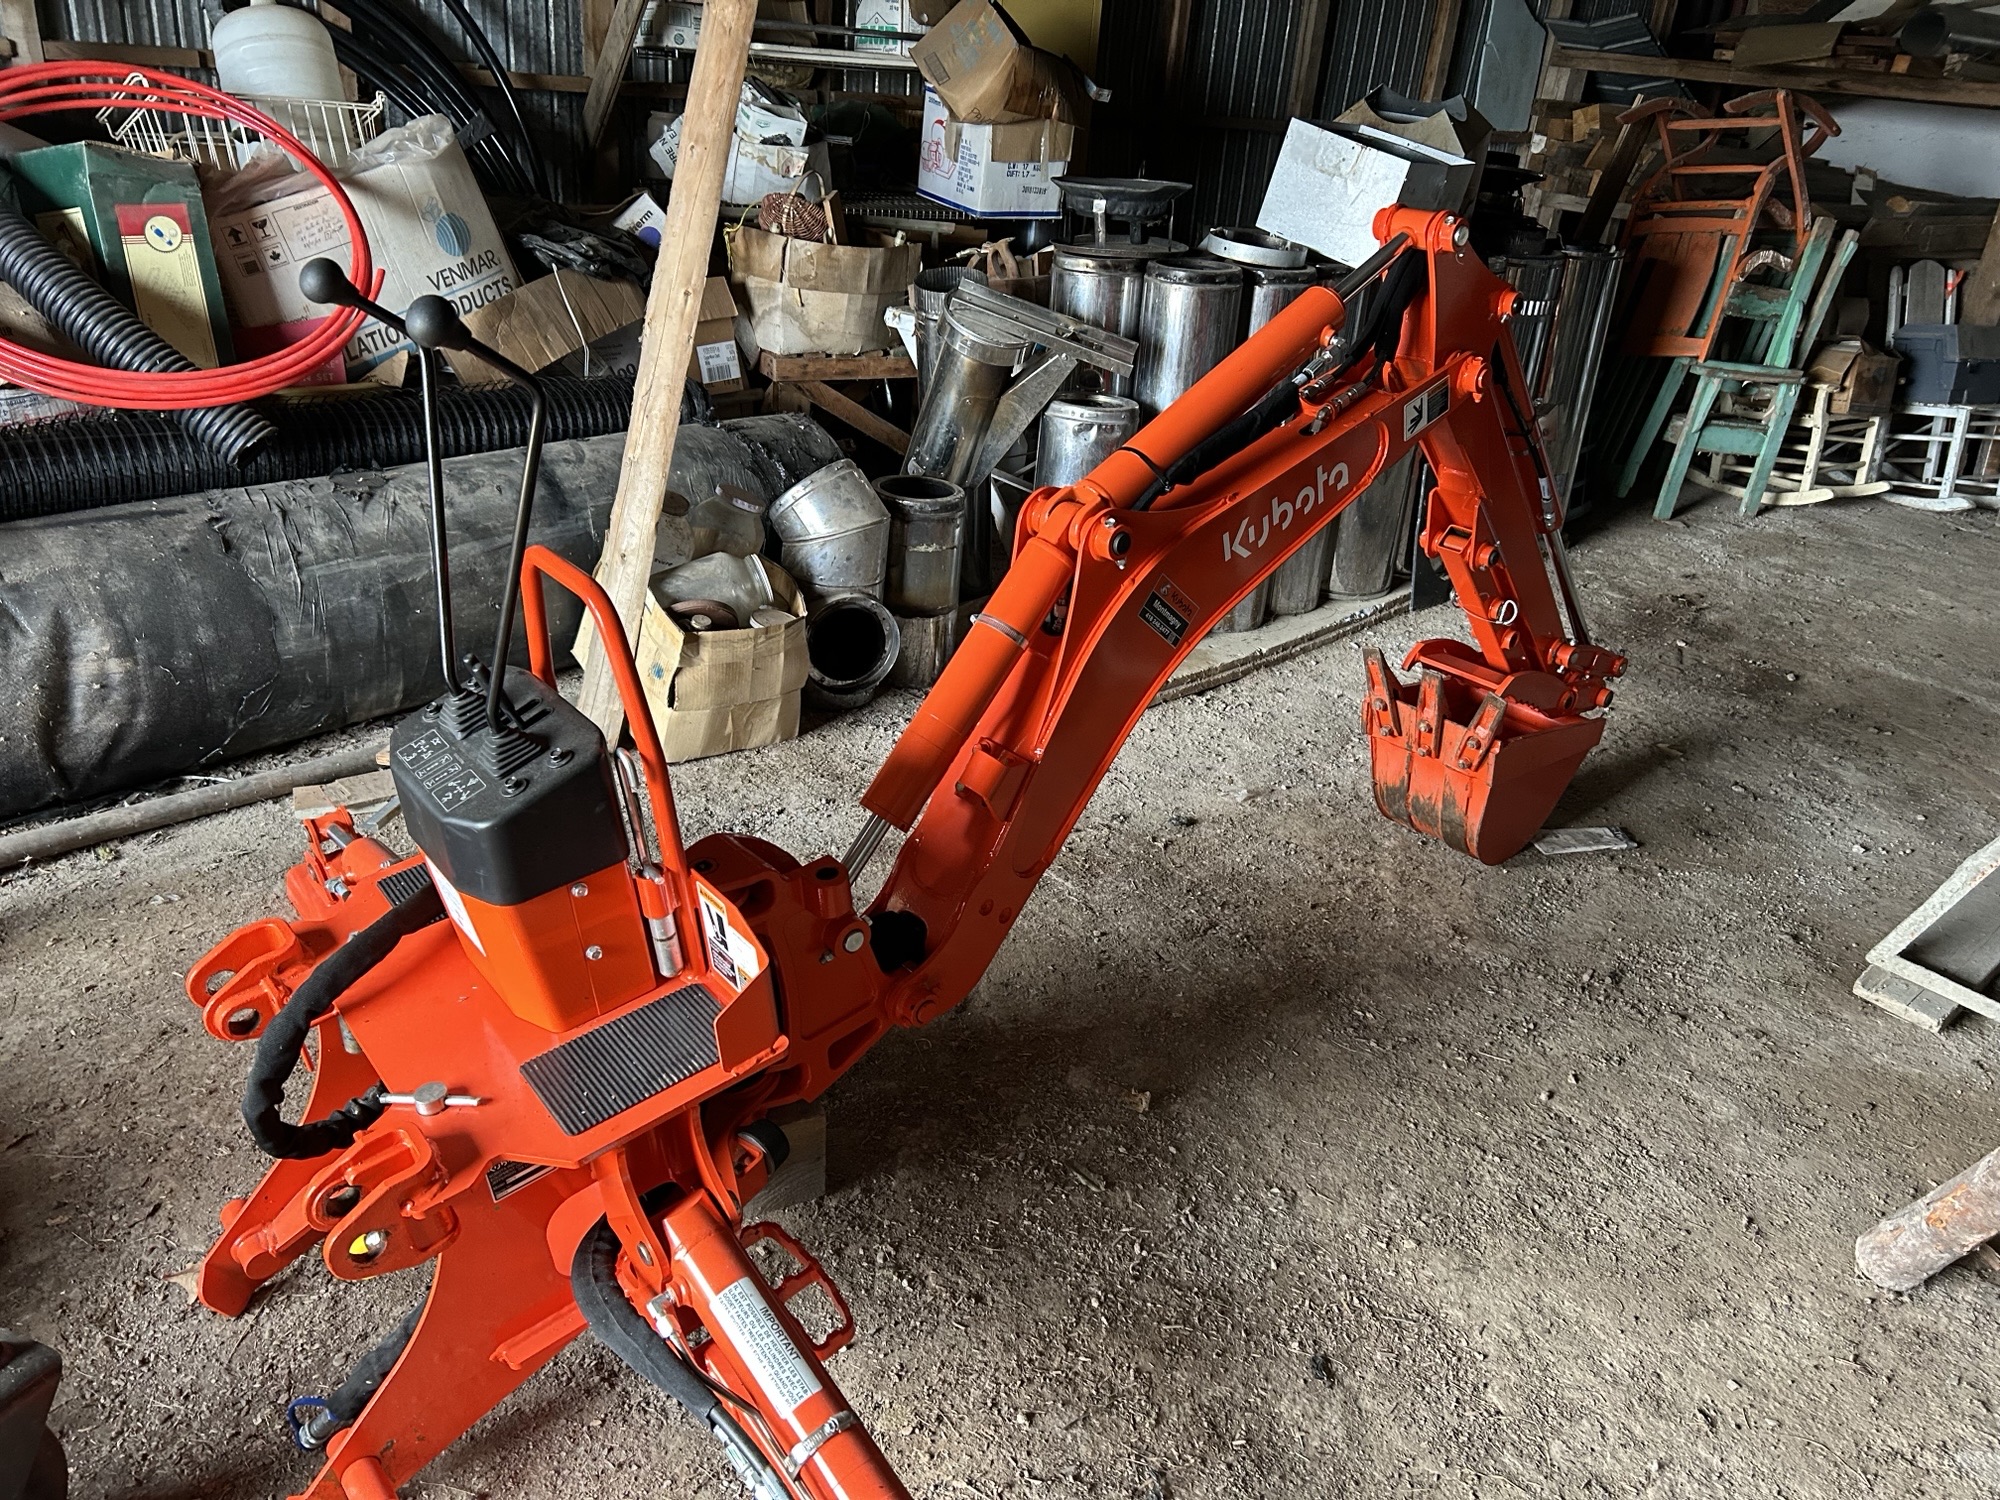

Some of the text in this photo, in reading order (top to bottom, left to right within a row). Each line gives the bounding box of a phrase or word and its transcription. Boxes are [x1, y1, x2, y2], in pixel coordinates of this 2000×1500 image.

[426, 250, 498, 291] VENMAR
[1222, 462, 1349, 562] Kubota
[1152, 599, 1182, 630] Montmagny
[722, 1292, 736, 1310] GODET
[734, 1310, 748, 1329] FAITES
[754, 1341, 776, 1370] ATTENTION
[772, 1369, 788, 1389] QUAND
[785, 1388, 798, 1404] VOUS
[737, 1290, 747, 1302] EST
[745, 1302, 765, 1330] POSSIBLE
[769, 1339, 789, 1366] HEURTER
[786, 1366, 797, 1378] LES
[748, 1319, 757, 1329] OU
[755, 1329, 765, 1342] LES
[763, 1342, 786, 1374] CYLINDRES
[784, 1374, 797, 1391] AVEC
[795, 1391, 804, 1400] LE
[759, 1305, 801, 1363] IMPORTANT
